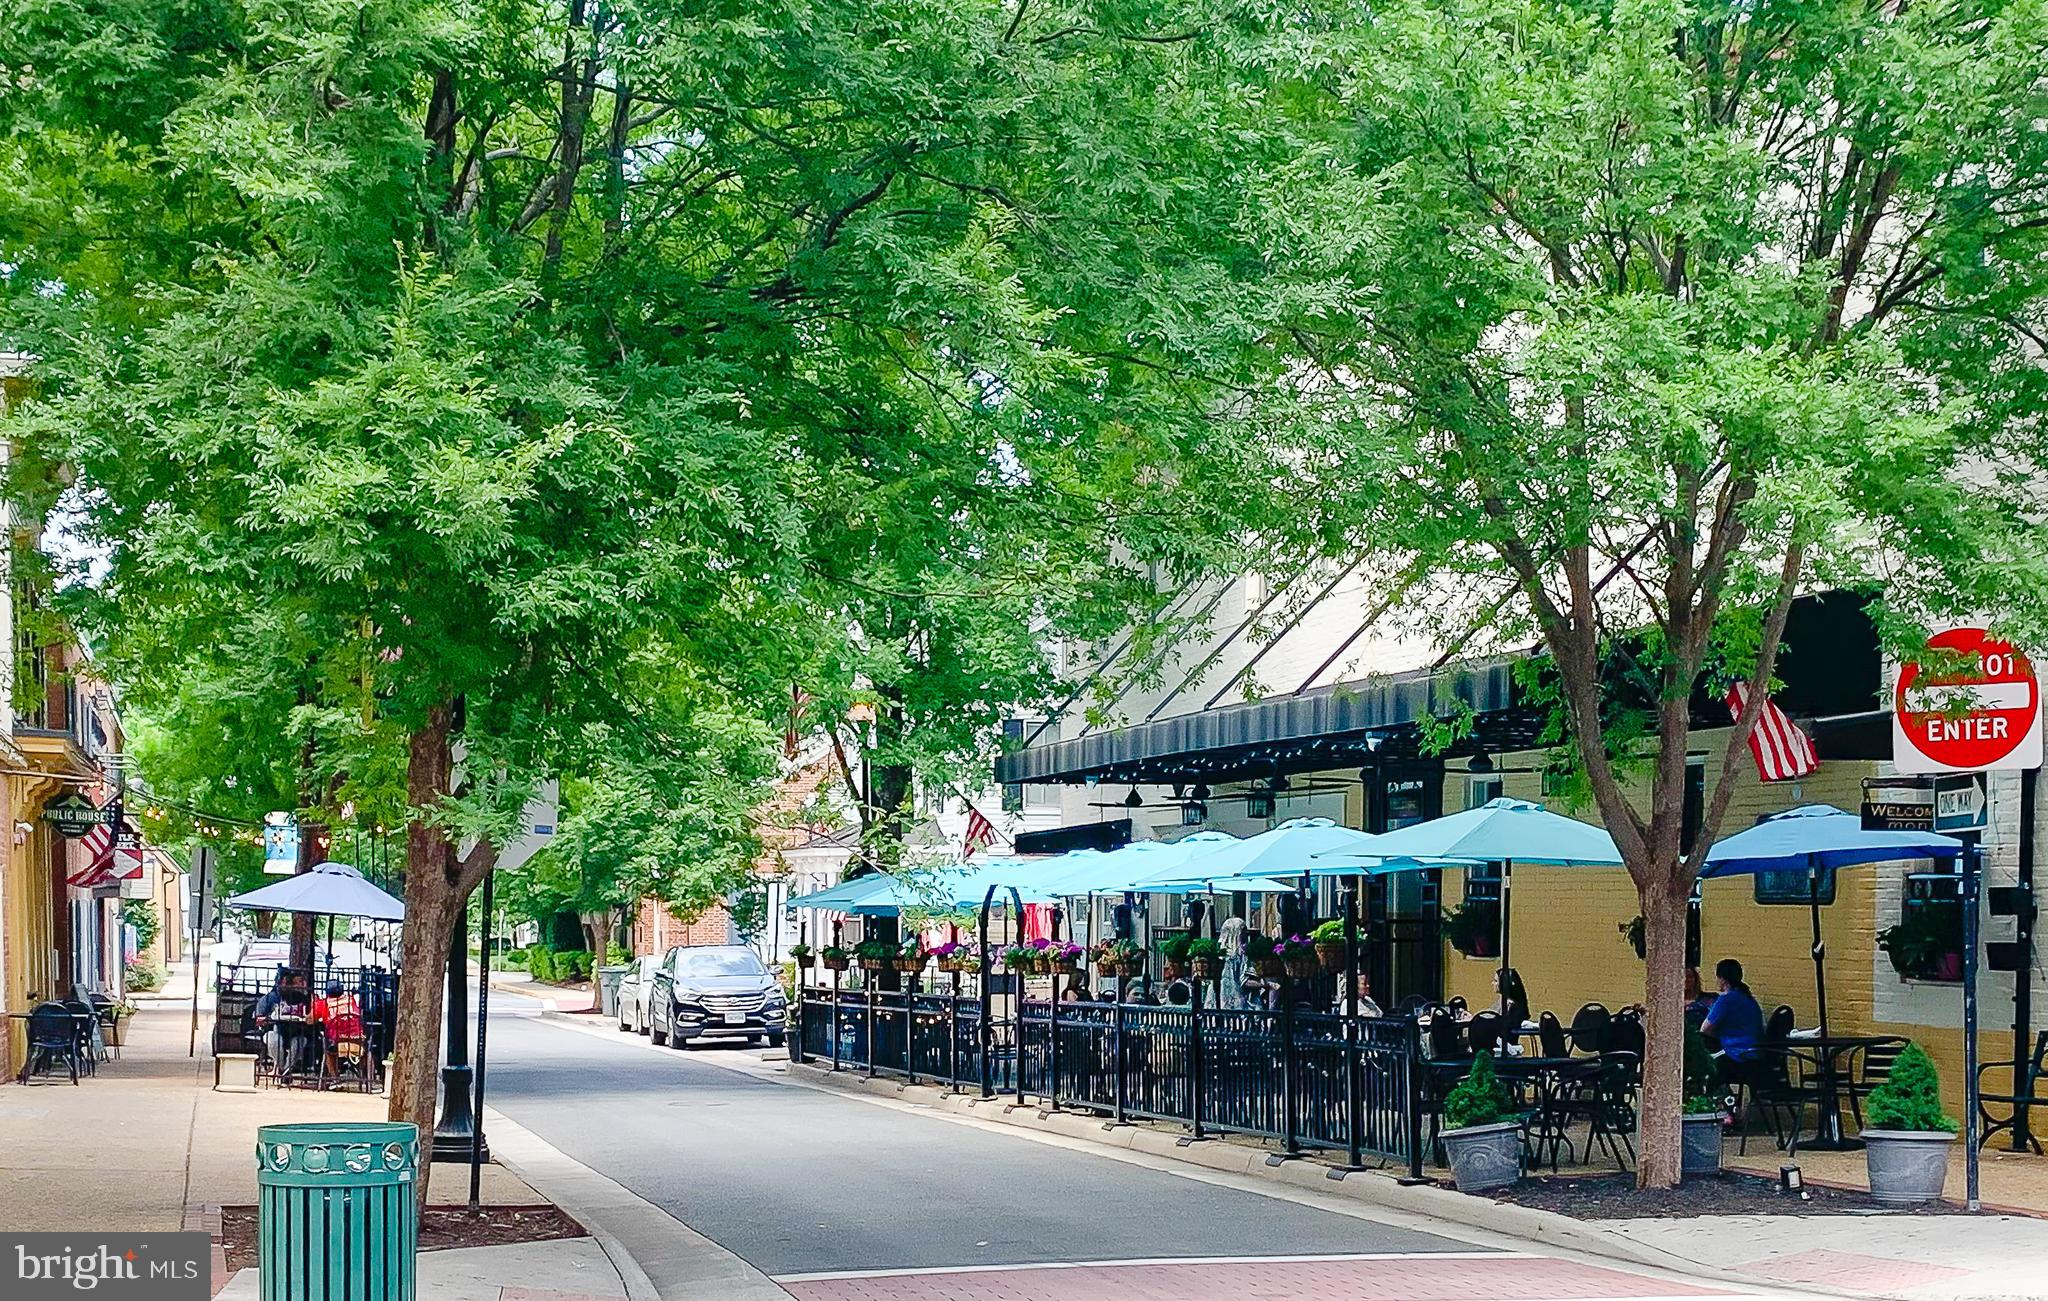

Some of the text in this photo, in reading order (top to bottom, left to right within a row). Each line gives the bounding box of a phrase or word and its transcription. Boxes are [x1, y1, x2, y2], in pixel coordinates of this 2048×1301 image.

[1927, 716, 2009, 742] ENTER
[1940, 790, 1973, 814] ONE WAY
[41, 808, 108, 823] PUBLIC HOUSE
